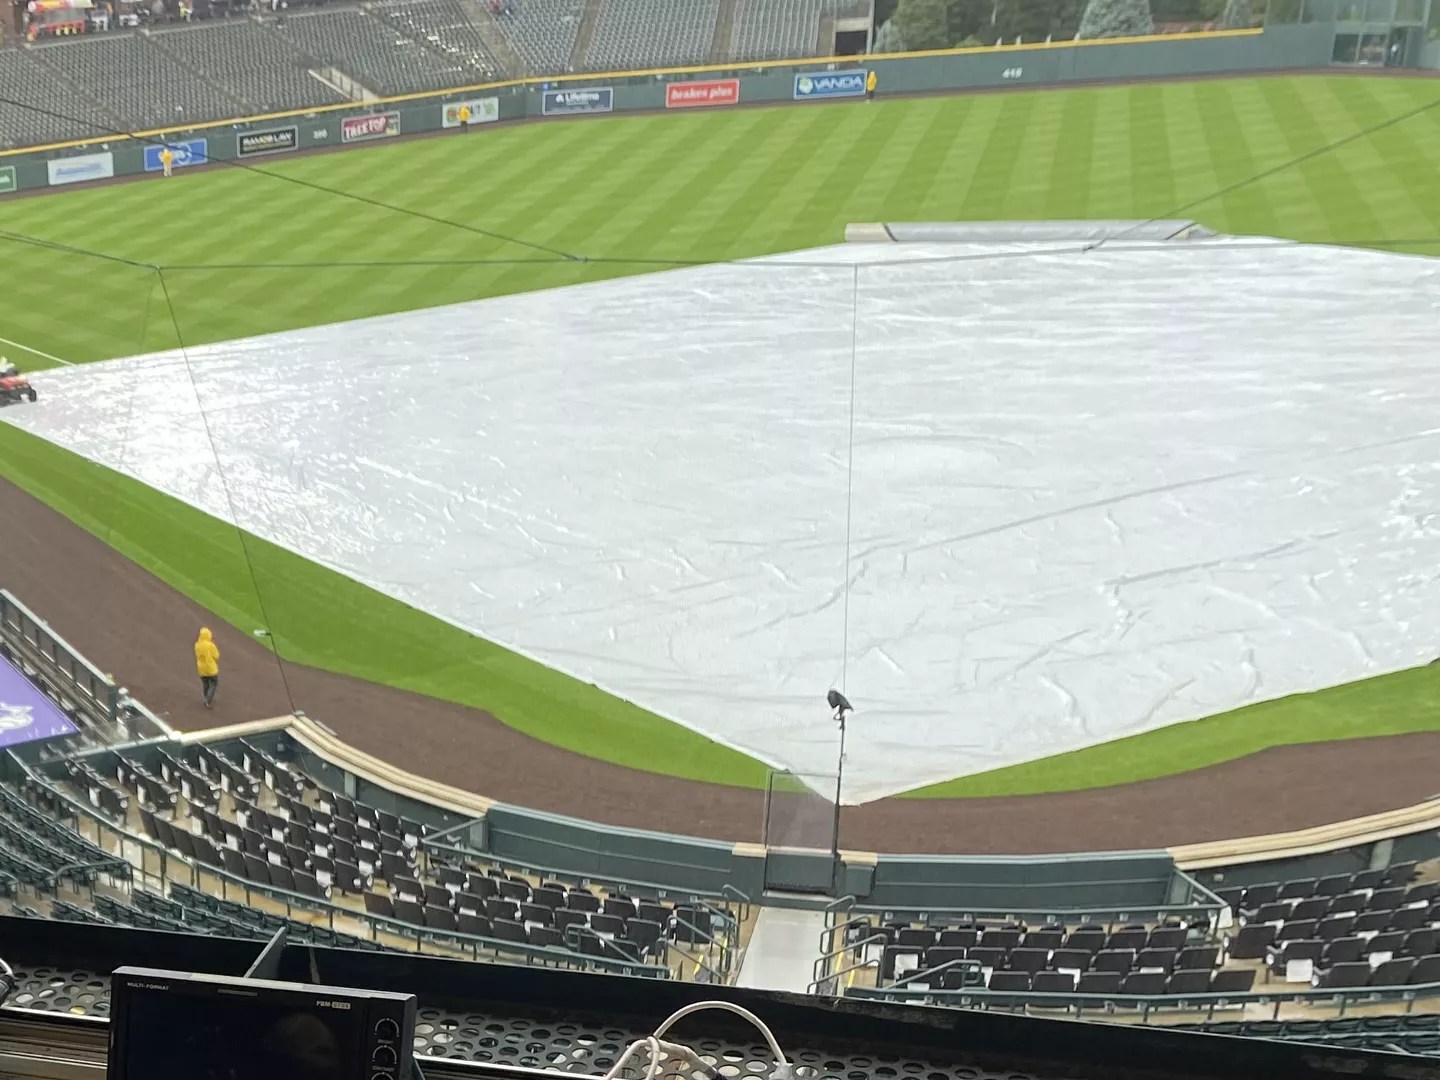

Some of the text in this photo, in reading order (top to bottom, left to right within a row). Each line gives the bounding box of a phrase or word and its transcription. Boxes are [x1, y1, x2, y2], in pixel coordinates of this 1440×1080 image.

[813, 75, 864, 90] VANDA
[671, 86, 733, 100] brakes plus
[127, 981, 170, 991] MULTI-FORMAT
